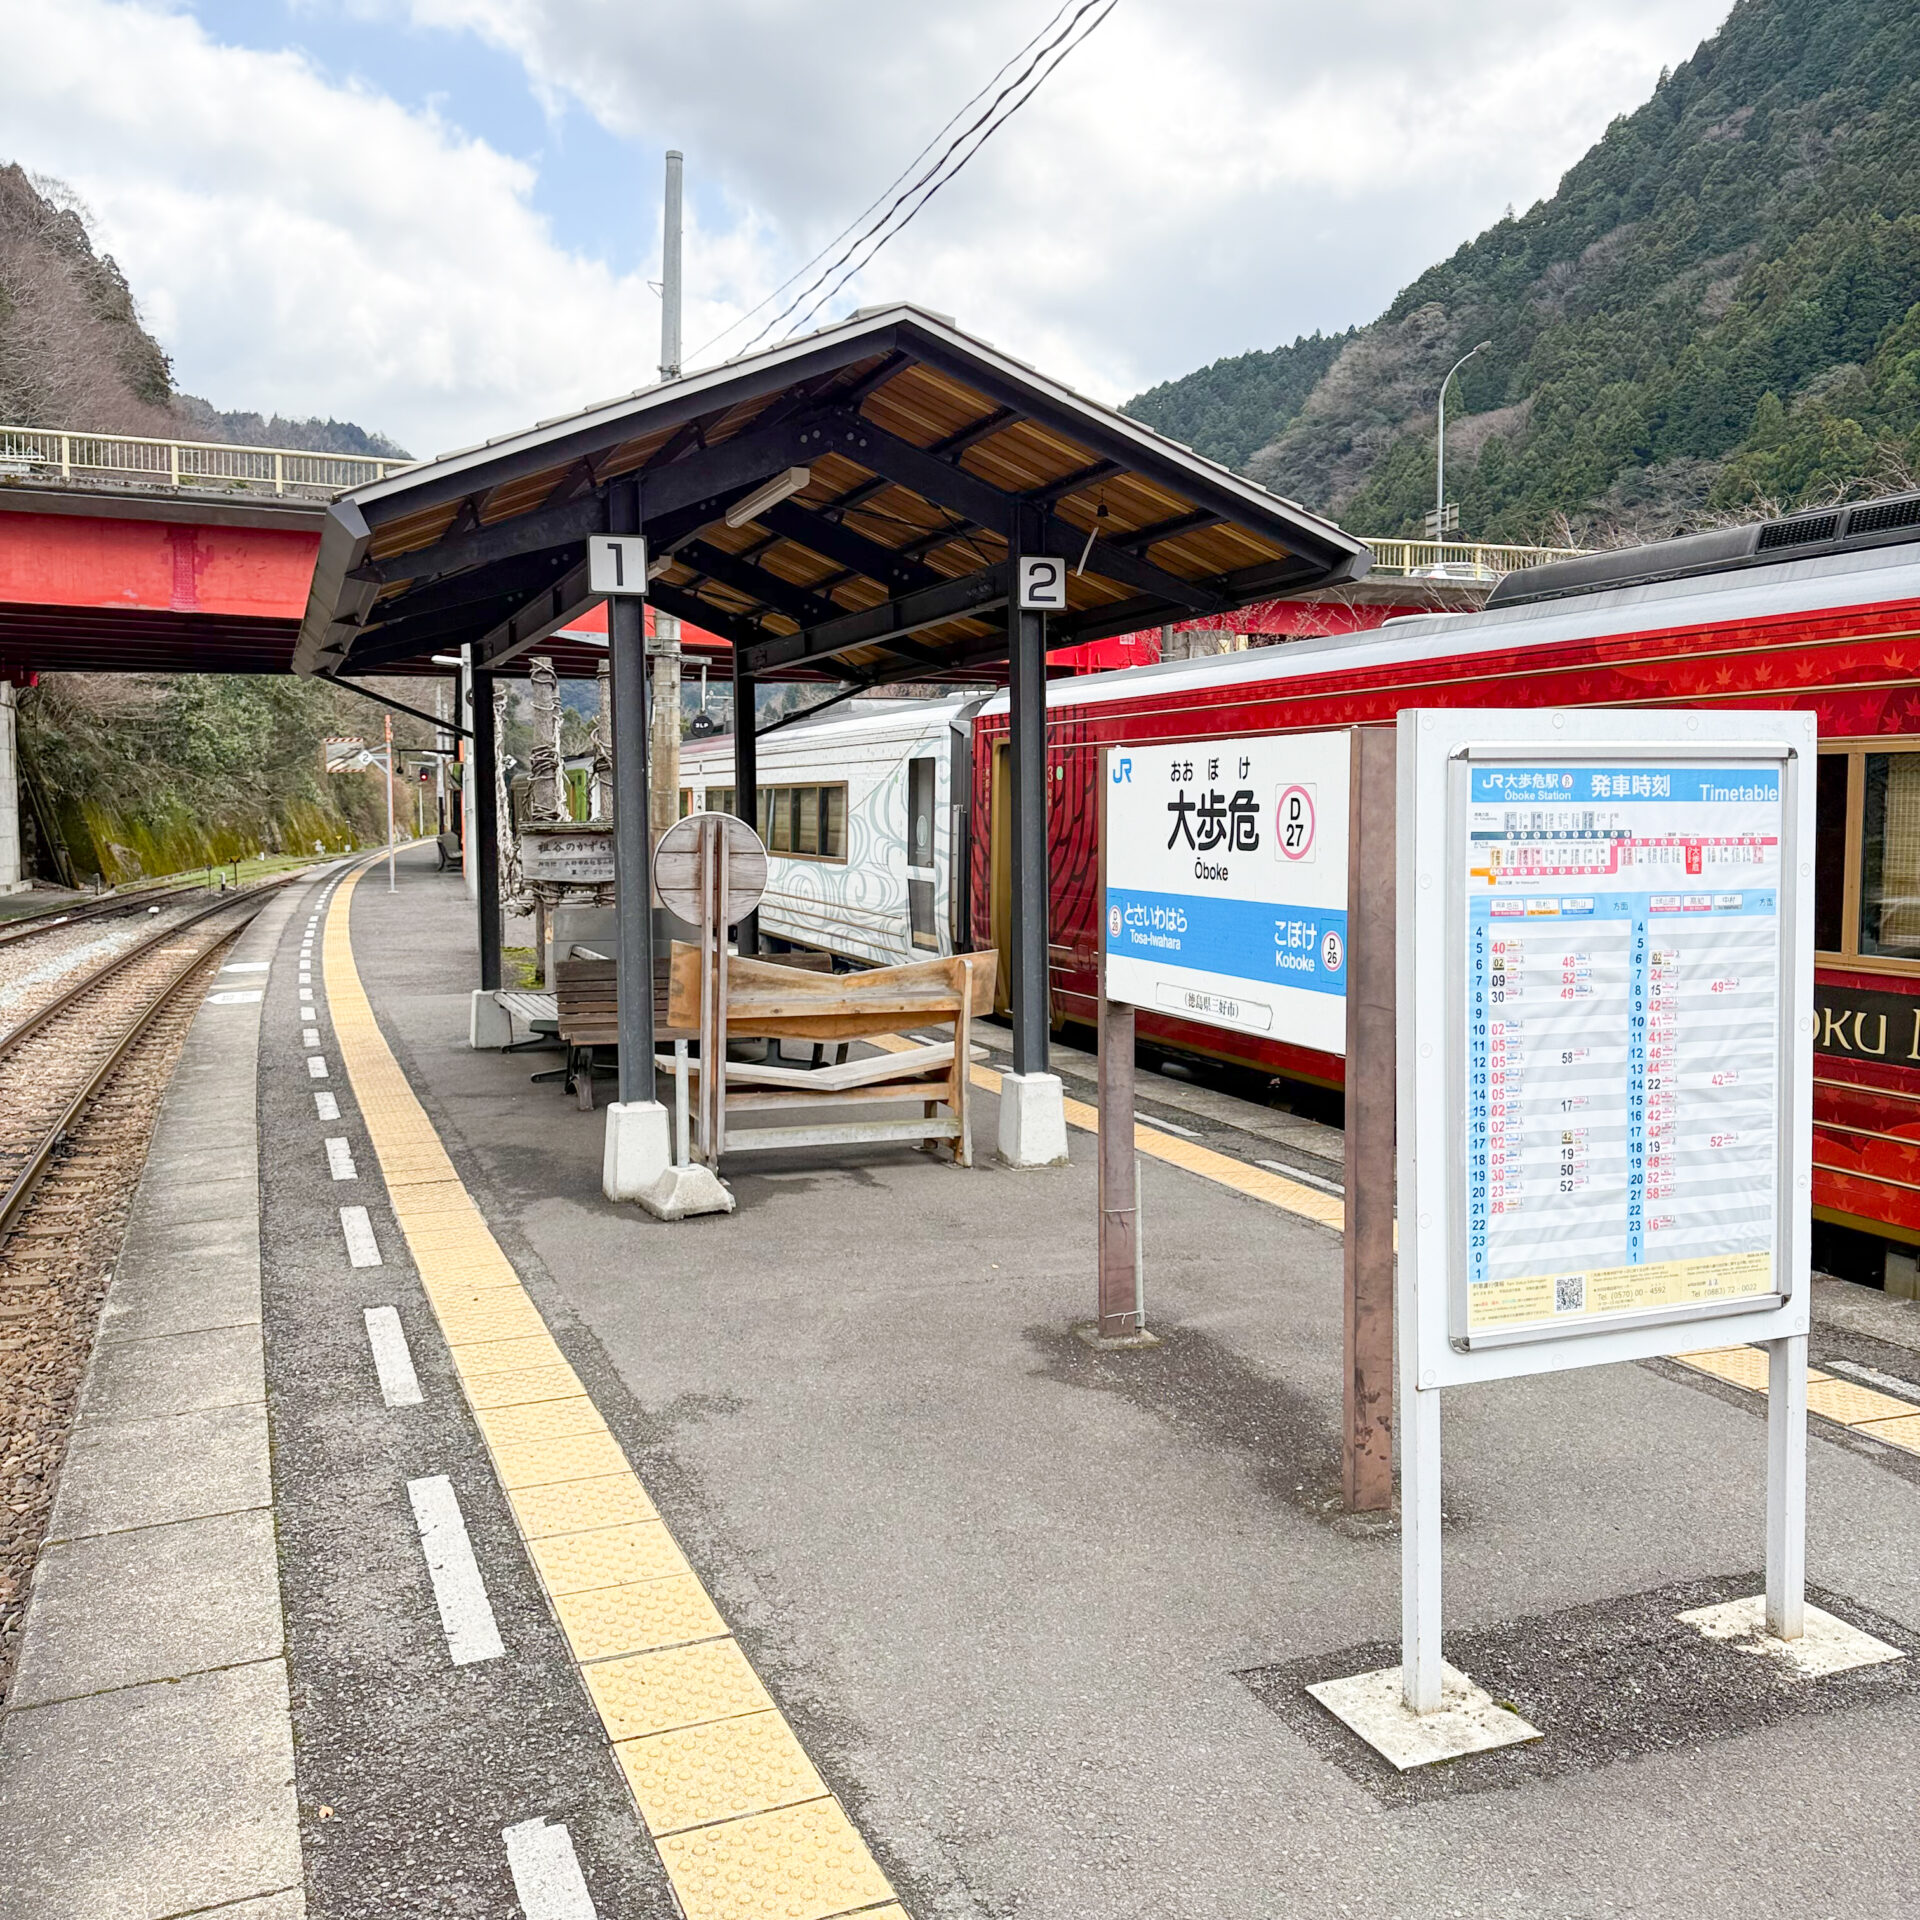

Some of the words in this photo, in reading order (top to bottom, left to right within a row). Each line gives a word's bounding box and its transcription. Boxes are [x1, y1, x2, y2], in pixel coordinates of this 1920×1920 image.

[607, 544, 624, 586] 1
[1028, 562, 1057, 602] 2
[362, 754, 369, 762] 2
[1113, 759, 1132, 783] JR
[1170, 760, 1193, 782] おお
[1208, 757, 1220, 780] ぼ
[1239, 756, 1250, 780] け
[1591, 774, 1670, 797] 発車時刻
[1538, 790, 1571, 800] Station
[1700, 784, 1777, 801] Timetable
[1290, 798, 1301, 821] D
[1168, 788, 1260, 852] 大歩危
[1286, 824, 1304, 847] 27
[1195, 857, 1228, 881] Ōboke
[1613, 902, 1628, 911] 方面
[1124, 902, 1188, 932] とさいわはら
[1476, 927, 1482, 937] 4
[1638, 922, 1643, 932] 4
[1130, 929, 1181, 950] Tosa-Iwahara
[1274, 920, 1317, 951] こぼけ
[1329, 938, 1335, 950] D
[1476, 943, 1482, 953] 5
[1492, 942, 1505, 954] 40
[1638, 938, 1643, 948] 5
[1276, 950, 1315, 972] Koboke
[1328, 951, 1337, 964] 26
[1476, 960, 1482, 969] 6
[1494, 958, 1503, 967] 02
[1563, 956, 1575, 967] 48
[1636, 954, 1642, 963] 6
[1476, 976, 1482, 986] 7
[1492, 975, 1505, 986] 09
[1562, 972, 1575, 984] 52
[1636, 970, 1641, 979] 7
[1651, 969, 1662, 980] 24
[1635, 985, 1641, 995] 8
[1711, 982, 1724, 992] 49
[1476, 992, 1482, 1002] 8
[1492, 991, 1504, 1002] 30
[1561, 988, 1573, 999] 49
[1636, 1001, 1641, 1011] 9
[1649, 1001, 1661, 1011] 42
[1476, 1009, 1482, 1018] 9
[1632, 1017, 1644, 1026] 10
[1650, 1017, 1661, 1027] 41
[1473, 1025, 1485, 1035] 10
[1492, 1024, 1504, 1035] 02
[1632, 1033, 1642, 1042] 11
[1649, 1032, 1662, 1042] 41
[1473, 1041, 1485, 1051] 11
[1492, 1040, 1505, 1051] 05
[1631, 1048, 1643, 1058] 12
[1650, 1048, 1661, 1058] 46
[1473, 1057, 1486, 1067] 12
[1492, 1056, 1505, 1067] 05
[1562, 1052, 1572, 1063] 58
[1631, 1064, 1643, 1074] 13
[1648, 1063, 1659, 1073] 44
[1474, 1074, 1486, 1084] 13
[1492, 1073, 1505, 1084] 05
[1631, 1080, 1642, 1090] 14
[1648, 1079, 1660, 1089] 22
[1712, 1074, 1724, 1085] 42
[1473, 1090, 1486, 1100] 14
[1492, 1089, 1504, 1100] 05
[1630, 1096, 1642, 1105] 15
[1649, 1094, 1661, 1105] 42
[1473, 1106, 1486, 1116] 15
[1492, 1105, 1505, 1116] 02
[1562, 1100, 1572, 1112] 17
[1630, 1111, 1641, 1121] 16
[1648, 1110, 1661, 1120] 42
[1473, 1122, 1485, 1132] 16
[1492, 1121, 1504, 1132] 02
[1630, 1127, 1641, 1136] 17
[1648, 1126, 1660, 1137] 42
[1473, 1138, 1485, 1149] 17
[1491, 1137, 1505, 1148] 02
[1630, 1143, 1642, 1152] 18
[1649, 1142, 1660, 1152] 19
[1710, 1136, 1722, 1147] 52
[1473, 1155, 1485, 1165] 18
[1492, 1154, 1504, 1165] 05
[1561, 1149, 1573, 1159] 19
[1631, 1158, 1641, 1168] 19
[1648, 1156, 1659, 1167] 48
[1473, 1171, 1485, 1181] 19
[1492, 1170, 1504, 1180] 30
[1561, 1165, 1573, 1175] 50
[1631, 1174, 1642, 1184] 20
[1648, 1172, 1659, 1183] 52
[1473, 1187, 1485, 1197] 20
[1492, 1186, 1504, 1197] 23
[1560, 1181, 1573, 1191] 52
[1631, 1190, 1641, 1200] 21
[1647, 1188, 1659, 1199] 58
[1473, 1204, 1484, 1214] 21
[1491, 1202, 1504, 1213] 28
[1630, 1205, 1640, 1215] 22
[1473, 1220, 1485, 1230] 22
[1630, 1221, 1640, 1230] 23
[1648, 1219, 1658, 1230] 16
[1472, 1237, 1485, 1247] 23
[1632, 1236, 1638, 1246] 0
[1475, 1252, 1481, 1263] 0
[1633, 1252, 1637, 1262] 1
[1476, 1268, 1481, 1279] 1
